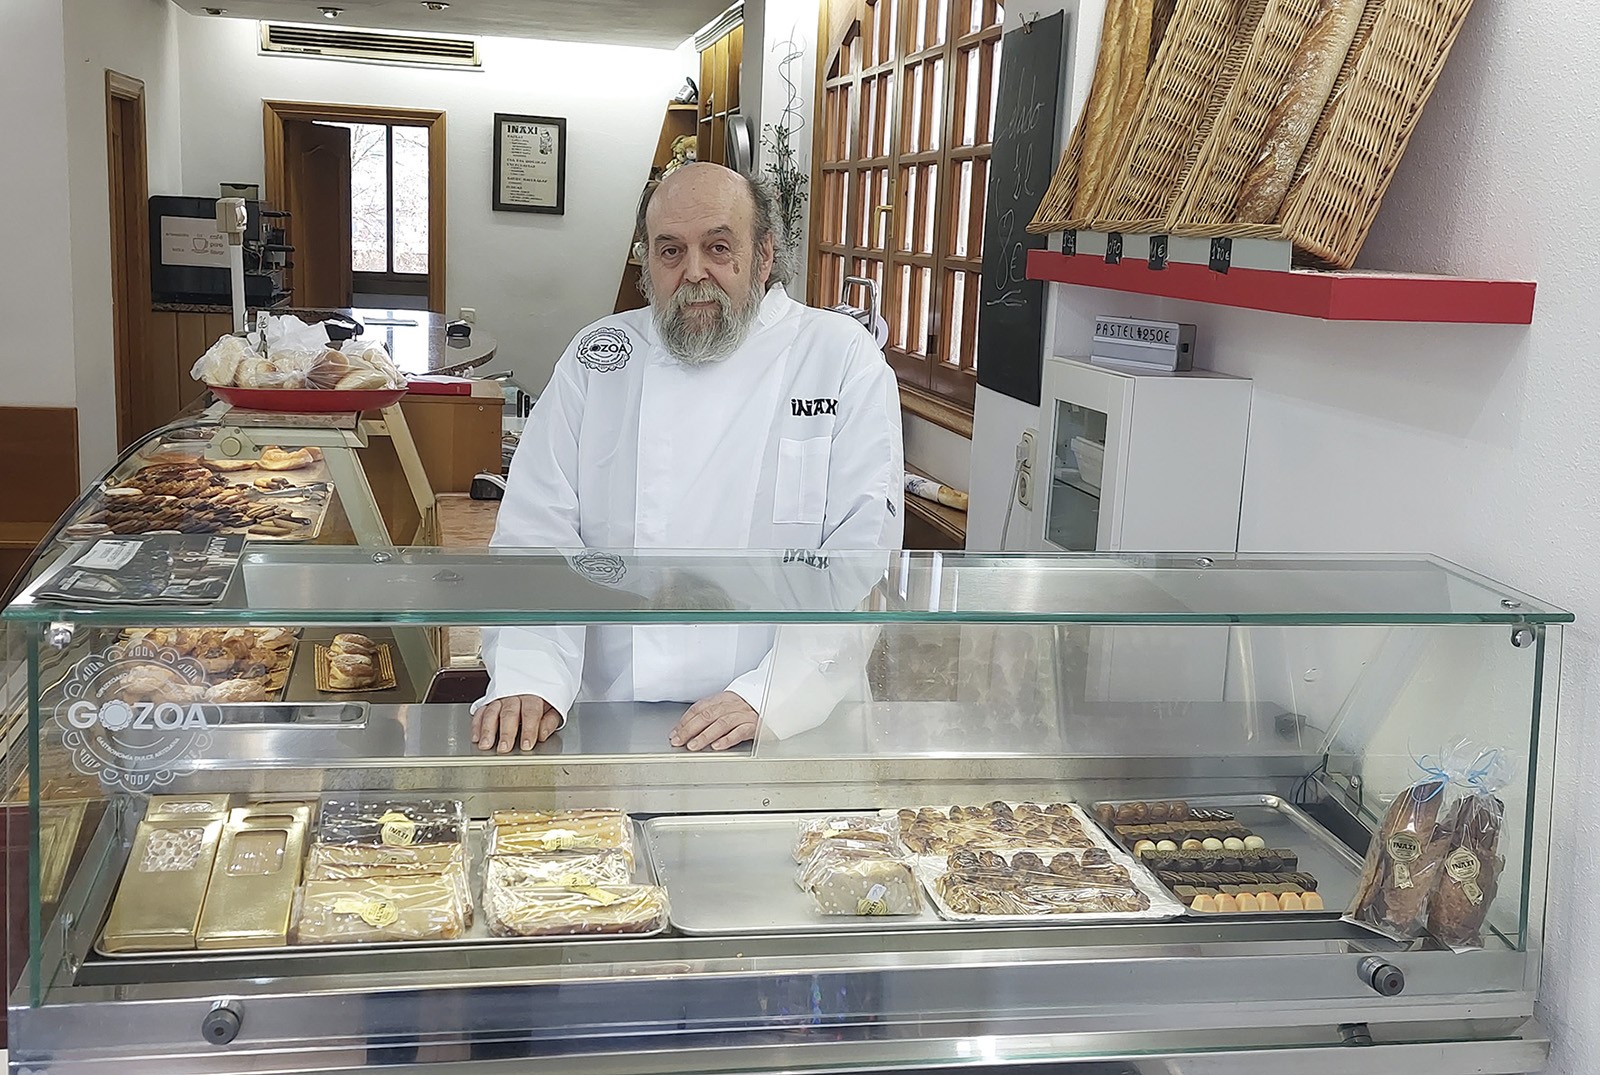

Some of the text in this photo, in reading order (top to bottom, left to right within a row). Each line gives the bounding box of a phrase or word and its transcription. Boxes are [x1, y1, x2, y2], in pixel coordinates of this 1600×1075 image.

[507, 124, 538, 135] INAXI
[1095, 323, 1134, 339] PASTEL
[1392, 841, 1416, 851] INAXI
[1451, 859, 1475, 871] INAXI
